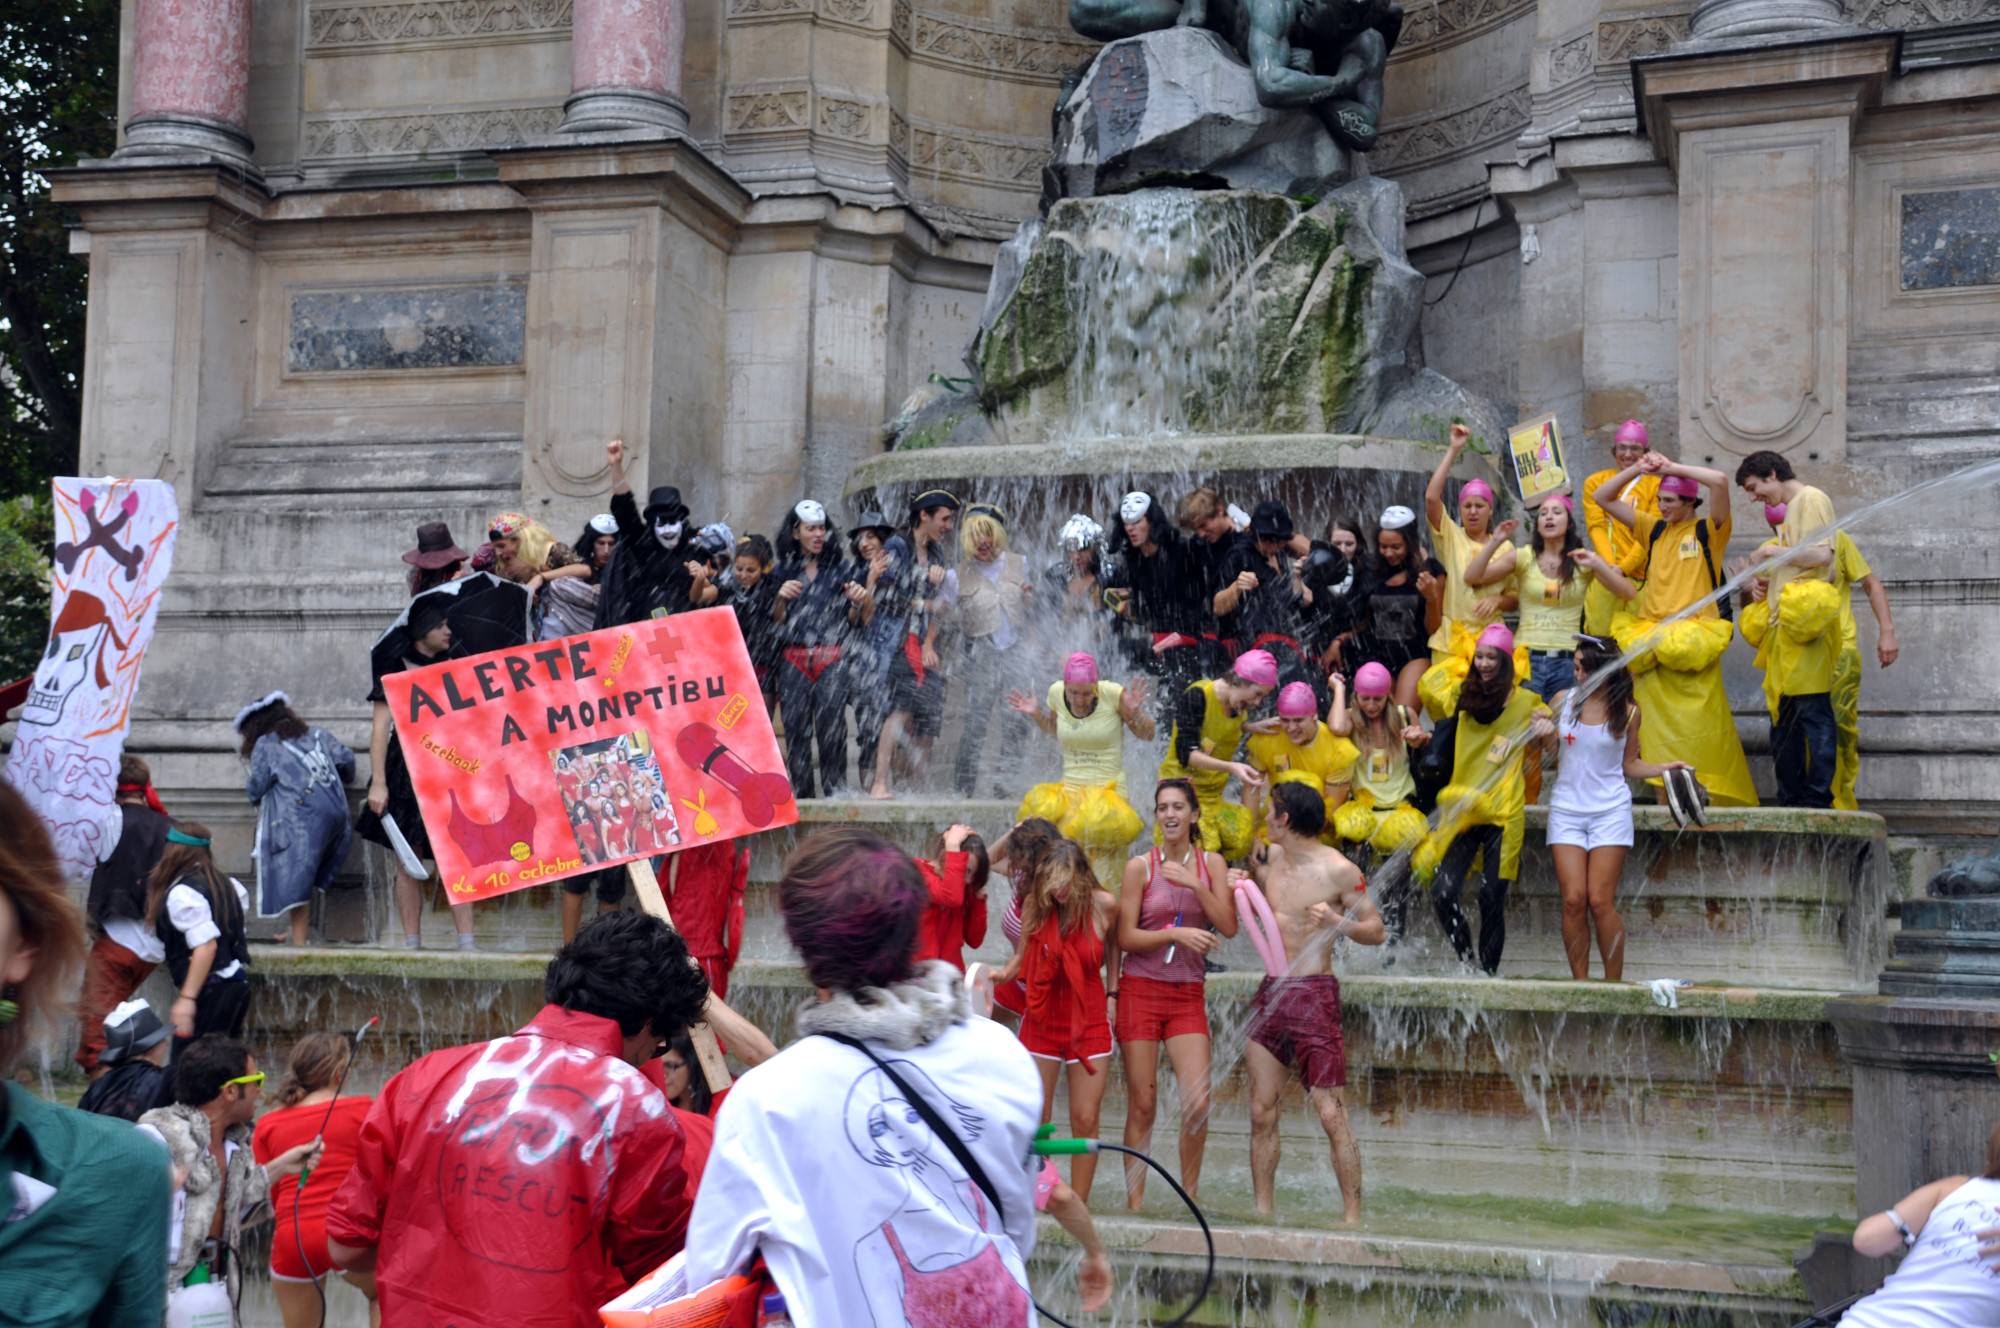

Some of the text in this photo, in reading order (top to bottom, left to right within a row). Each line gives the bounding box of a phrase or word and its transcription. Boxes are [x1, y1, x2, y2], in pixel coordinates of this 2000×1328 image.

[409, 640, 598, 723] ALERTE
[501, 714, 527, 746] A
[419, 733, 480, 775] facebook
[451, 857, 580, 893] Le 10 octobre
